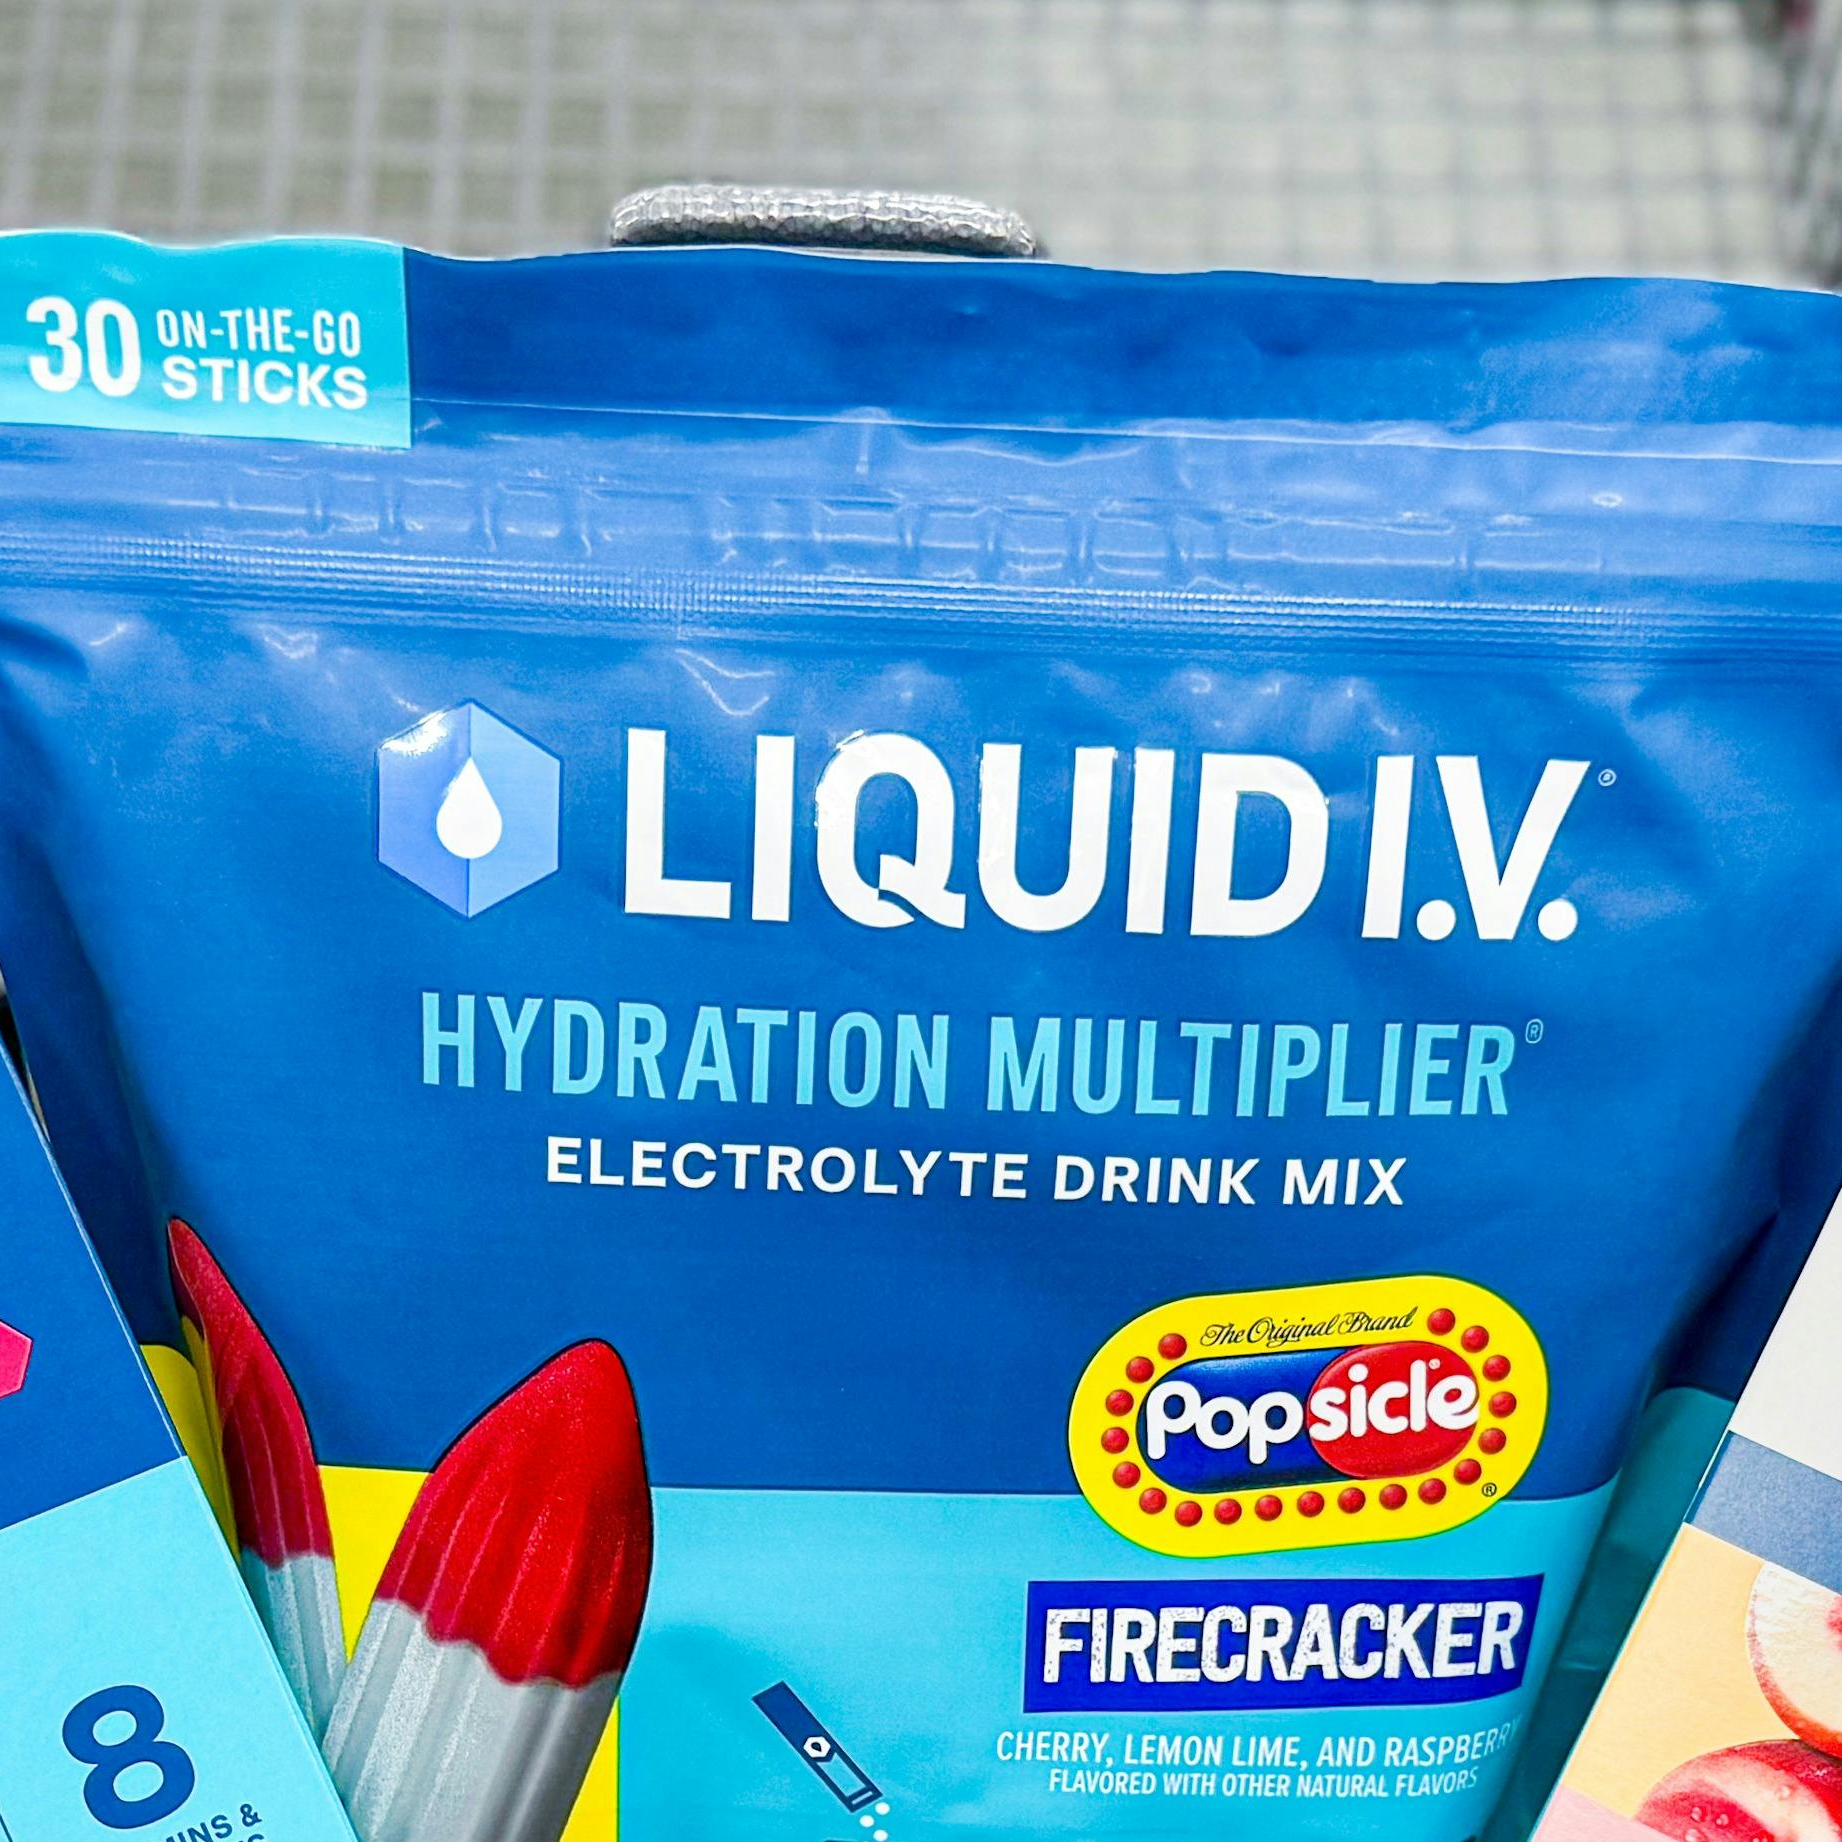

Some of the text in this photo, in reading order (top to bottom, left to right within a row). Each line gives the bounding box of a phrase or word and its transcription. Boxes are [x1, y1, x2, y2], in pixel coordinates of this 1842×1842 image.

[25, 296, 360, 397] 30 ON-THE-GO
[161, 356, 368, 411] STICKS
[624, 727, 1591, 941] LIQUID I.V.
[422, 991, 1515, 1118] HYDRATION MULTIPLIER
[546, 1135, 1407, 1206] ELECTROLYTE DRINK MIX
[1200, 1305, 1419, 1348] The Original Brand
[1043, 1600, 1525, 1684] FIRECRACKER
[62, 1684, 195, 1830] 8
[996, 1730, 1115, 1768] CHERRY,
[1123, 1733, 1224, 1767] LEMON
[1231, 1734, 1309, 1771] LIME,
[1316, 1736, 1376, 1768] AND
[1048, 1765, 1480, 1798] FLAVORED WITH OTHER NATURAL FLAVORS
[239, 1803, 263, 1827] &
